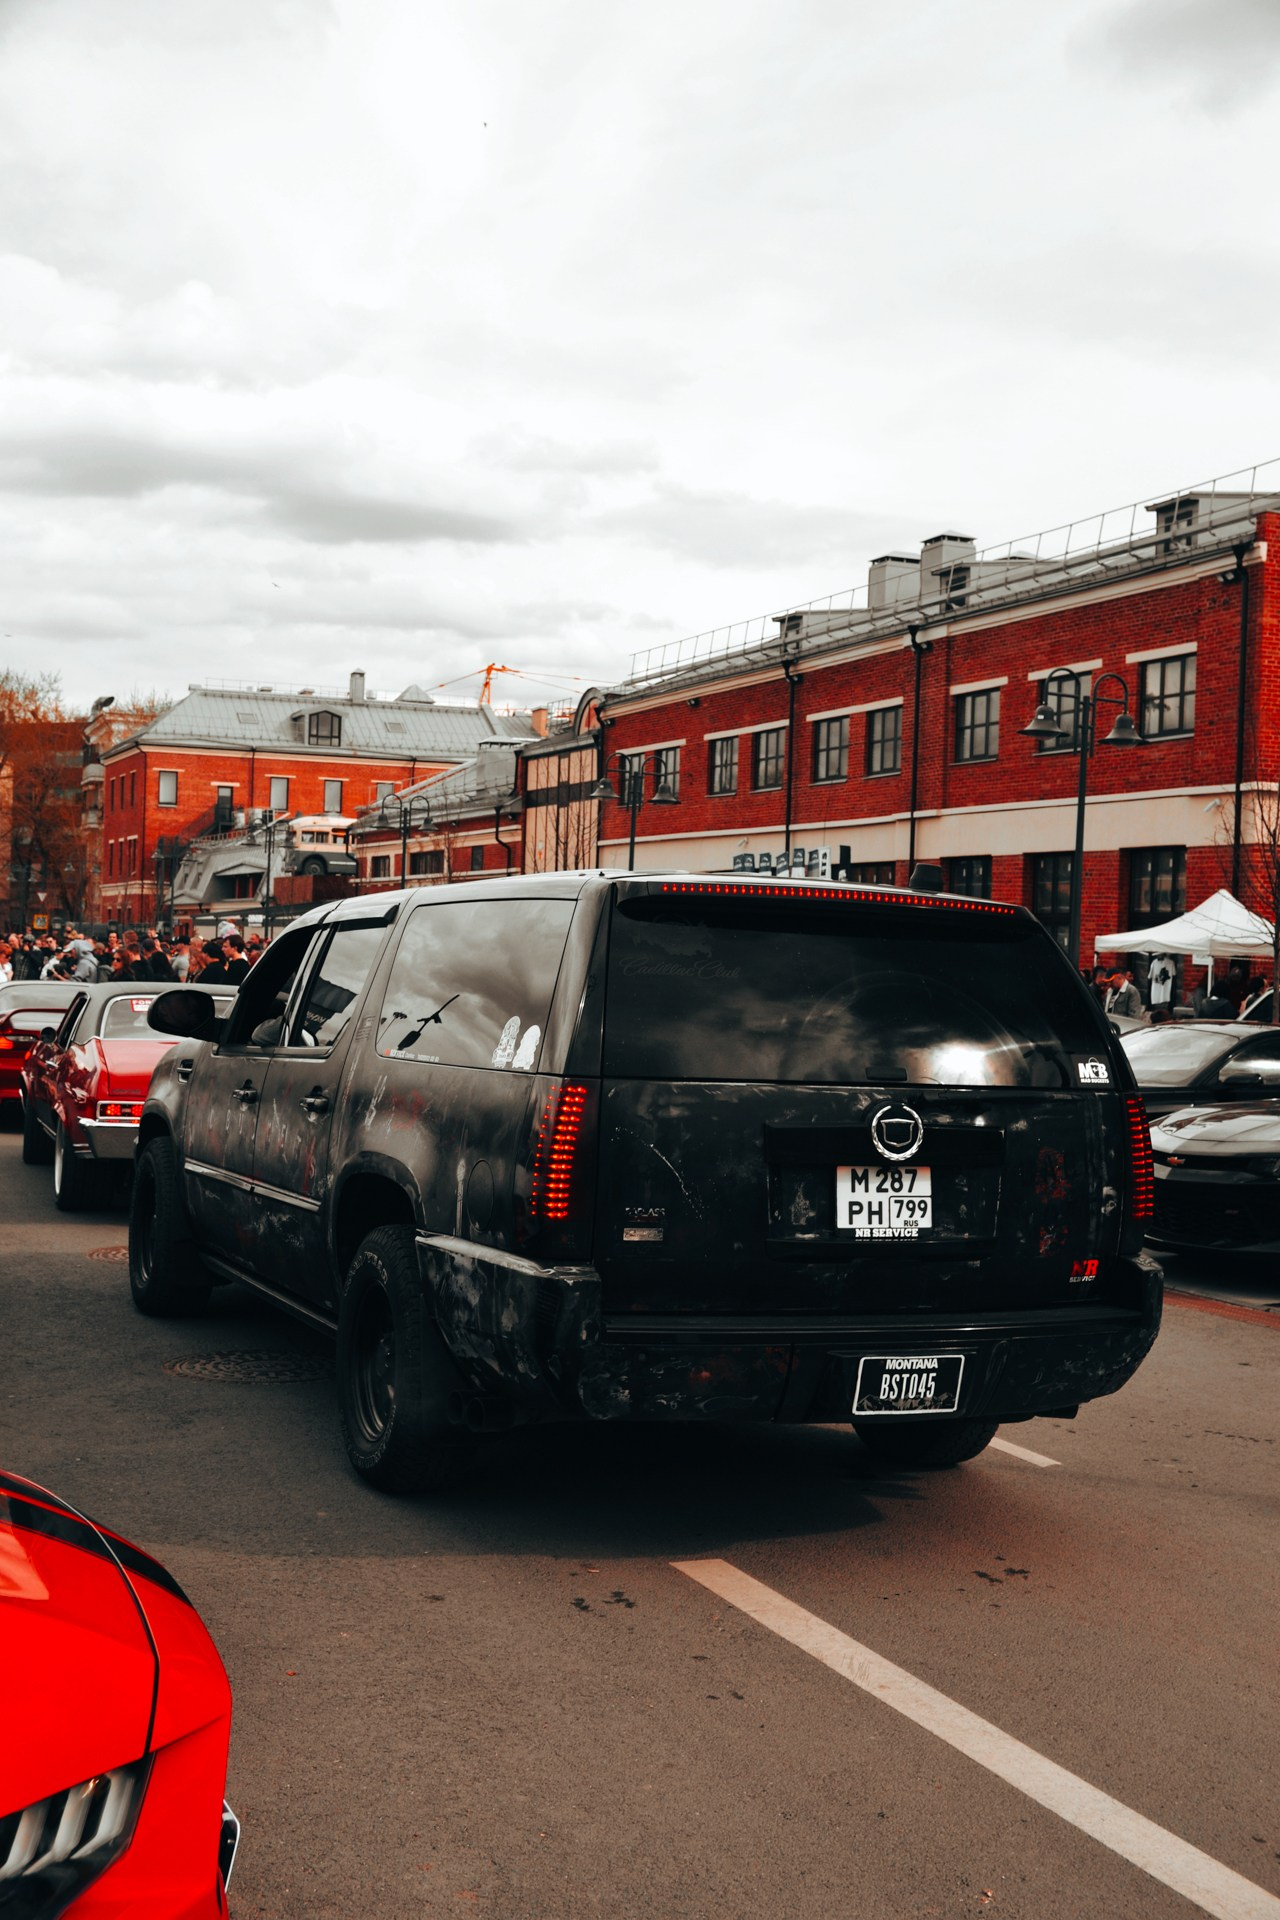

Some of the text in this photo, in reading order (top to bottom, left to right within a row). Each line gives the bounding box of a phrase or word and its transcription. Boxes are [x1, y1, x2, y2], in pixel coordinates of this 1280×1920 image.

[848, 1200, 928, 1225] PH 799
[855, 1228, 919, 1238] NR SERVICE
[885, 1358, 938, 1370] MONTANA
[880, 1373, 937, 1400] BST045
